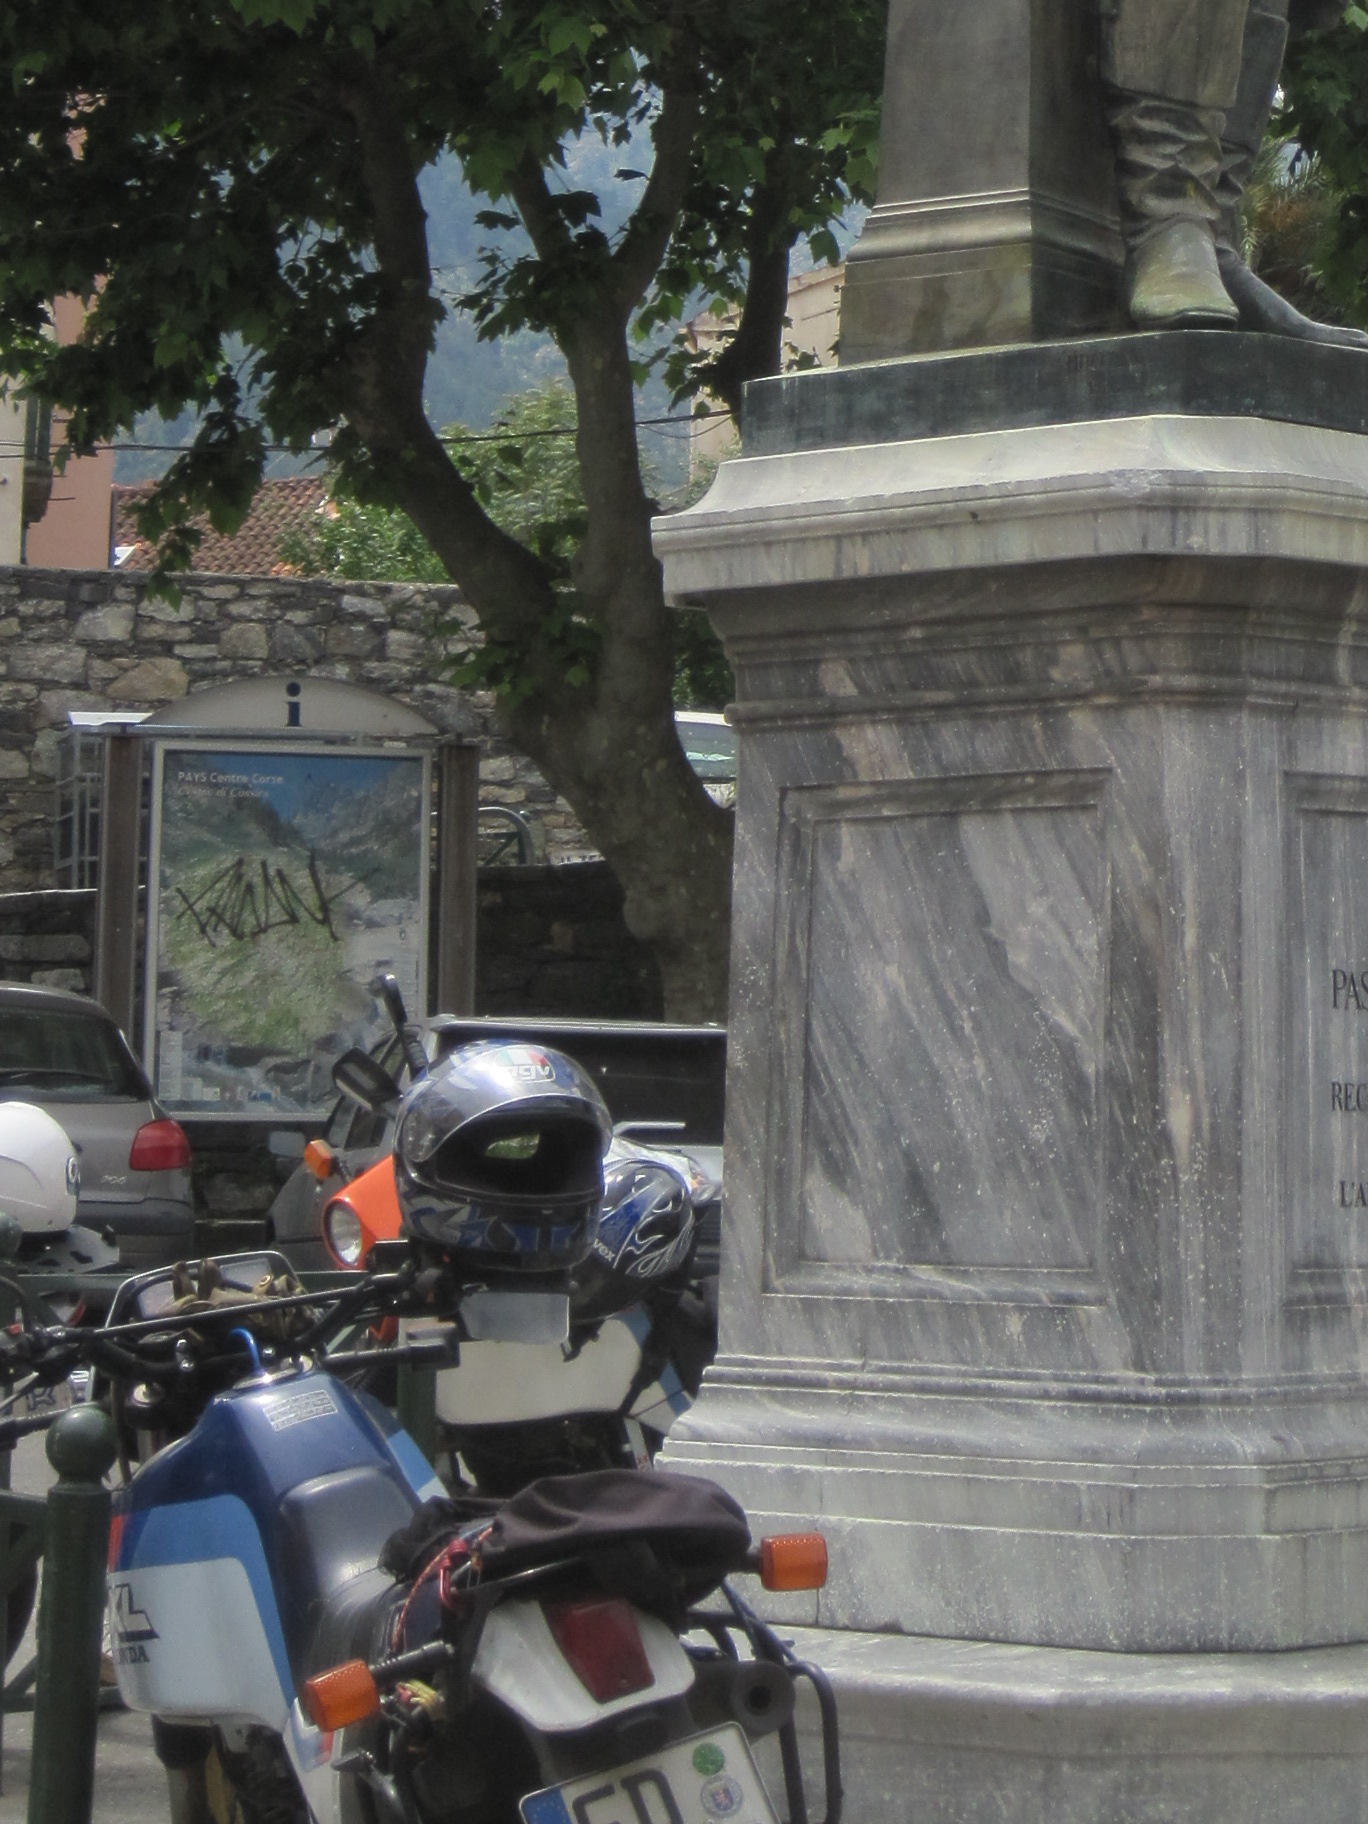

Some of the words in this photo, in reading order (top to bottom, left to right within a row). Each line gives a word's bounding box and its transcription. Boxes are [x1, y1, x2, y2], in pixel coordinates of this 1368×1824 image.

[178, 771, 207, 783] PAYS
[210, 772, 249, 784] Centre
[251, 774, 284, 784] Corse
